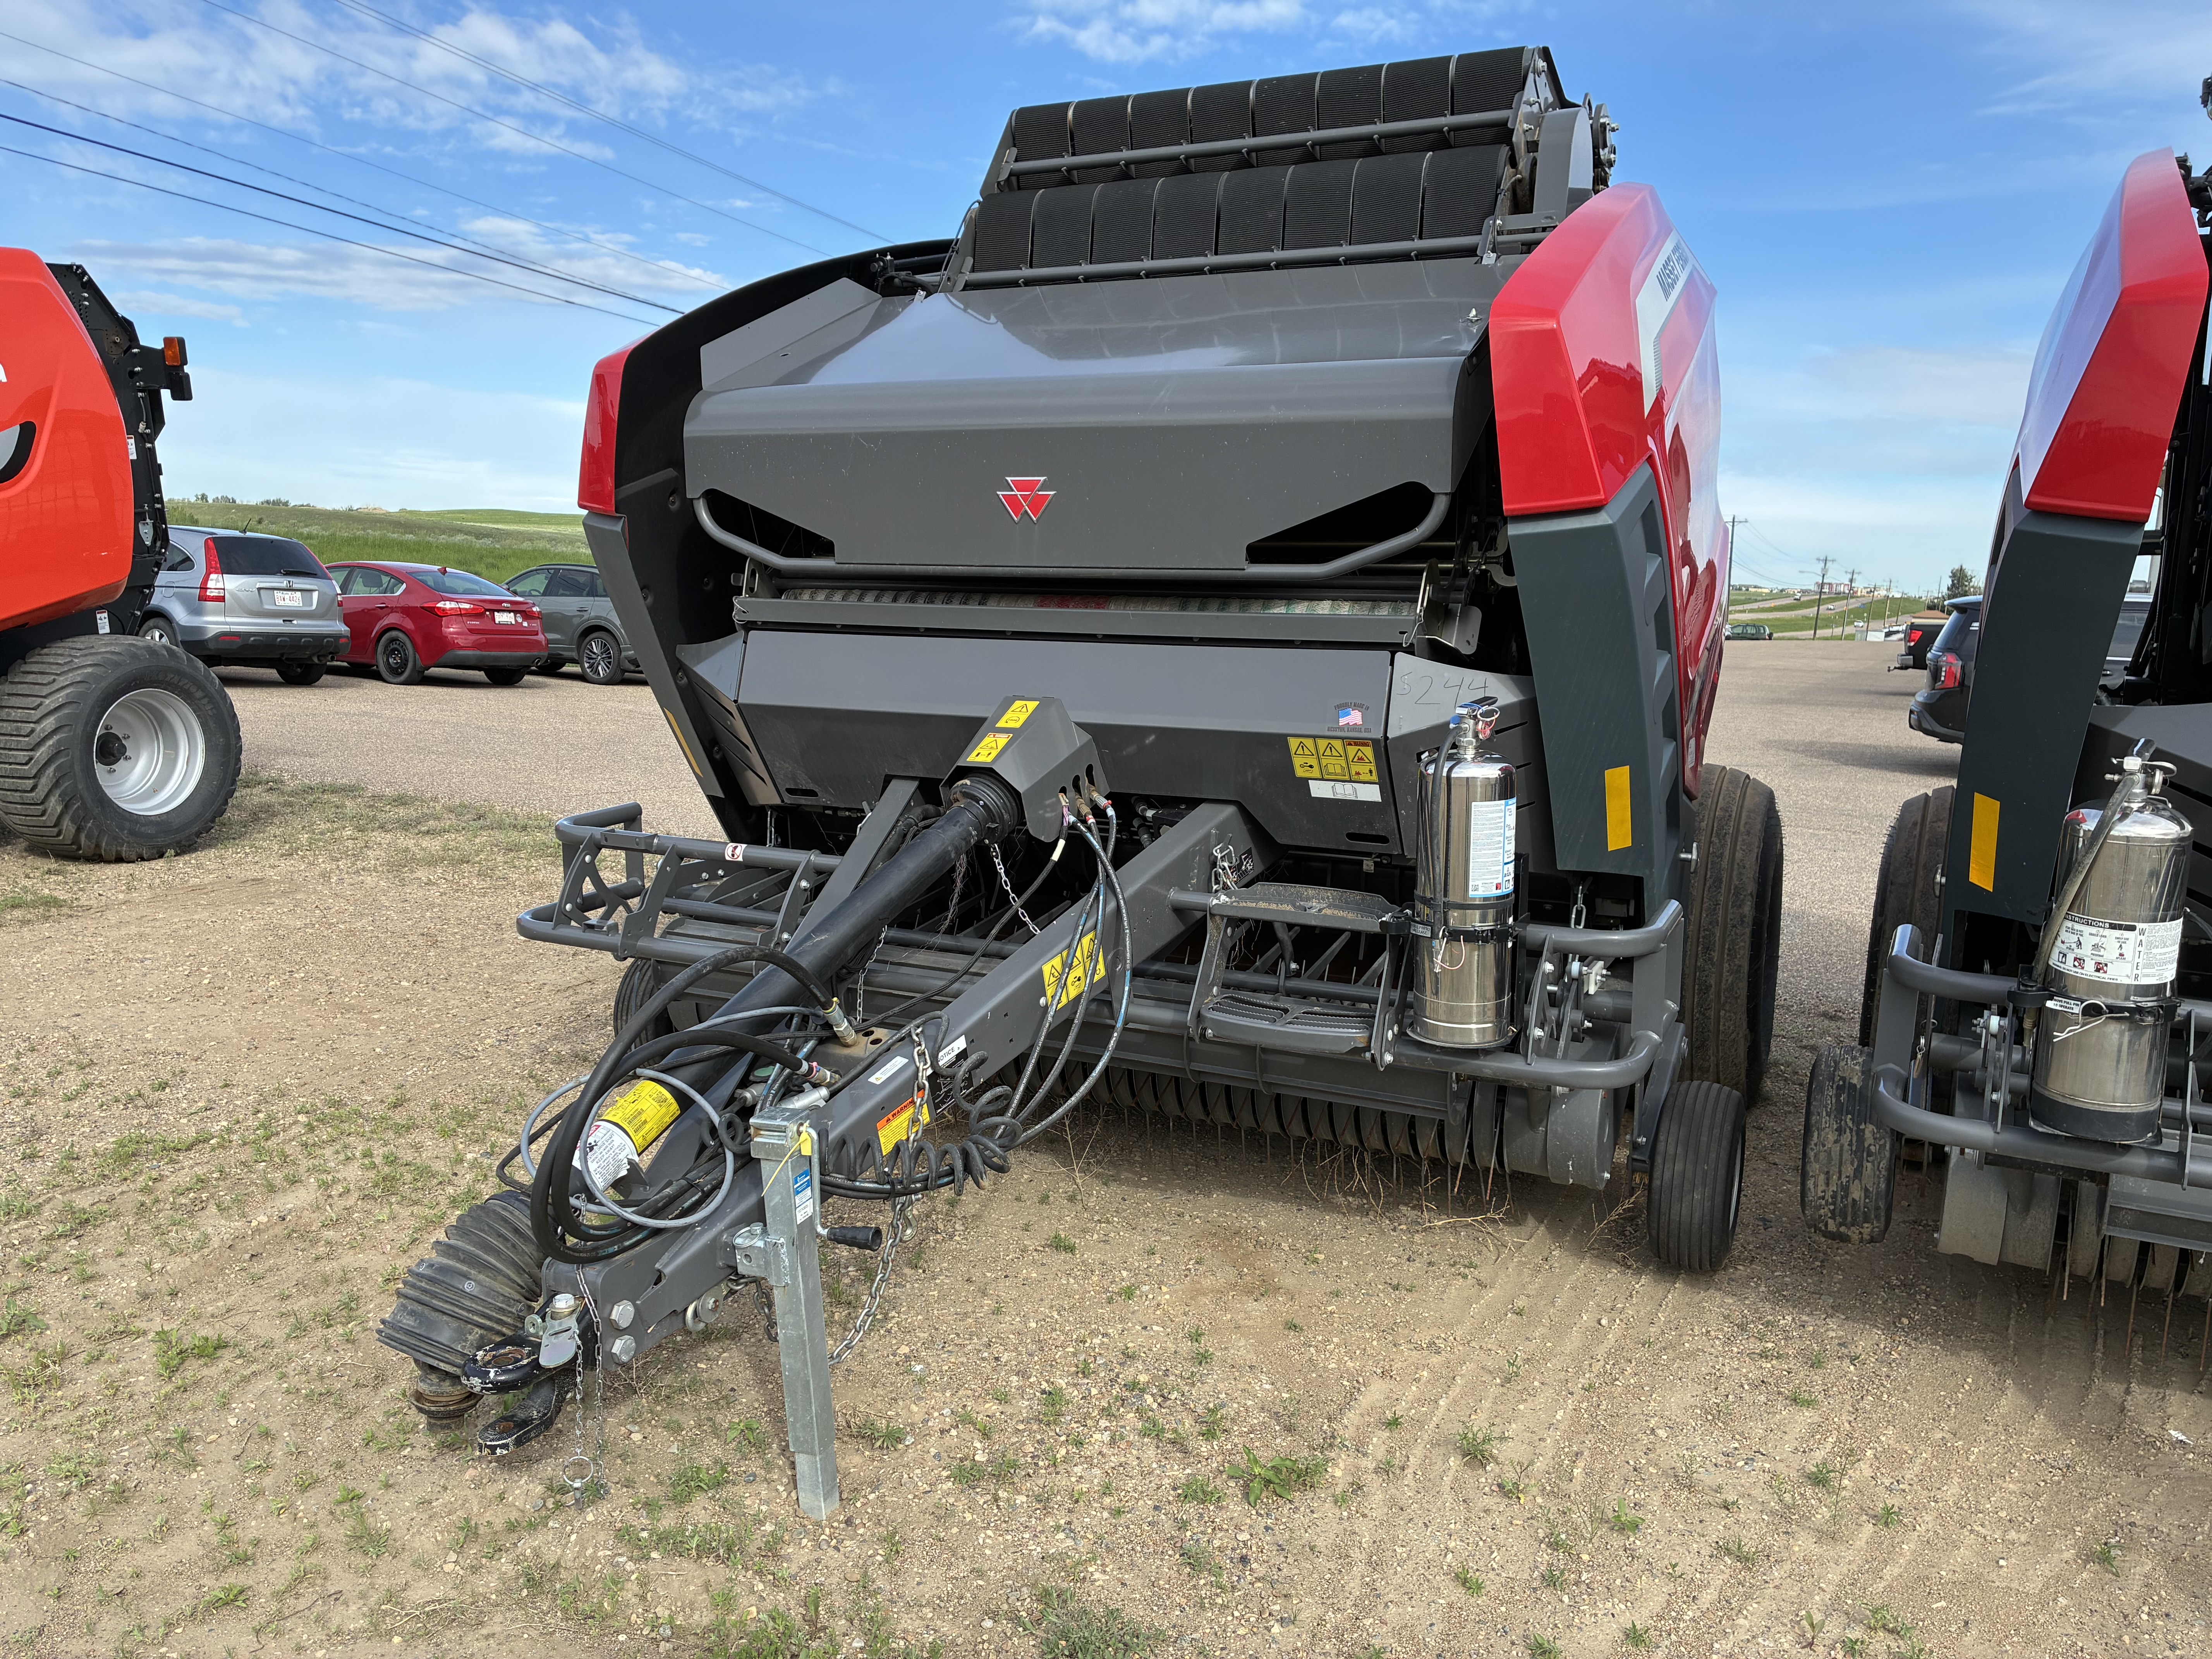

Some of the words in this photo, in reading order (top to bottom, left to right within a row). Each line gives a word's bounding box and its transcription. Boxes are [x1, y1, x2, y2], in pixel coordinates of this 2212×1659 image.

[1656, 252, 1681, 302] MASSEY
[1334, 702, 1352, 710] PROUDLY
[2065, 913, 2109, 929] NSTRUCTIONS
[2134, 928, 2146, 981] WATER
[891, 1099, 914, 1118] WARNIN
[595, 1154, 606, 1164] KEEP
